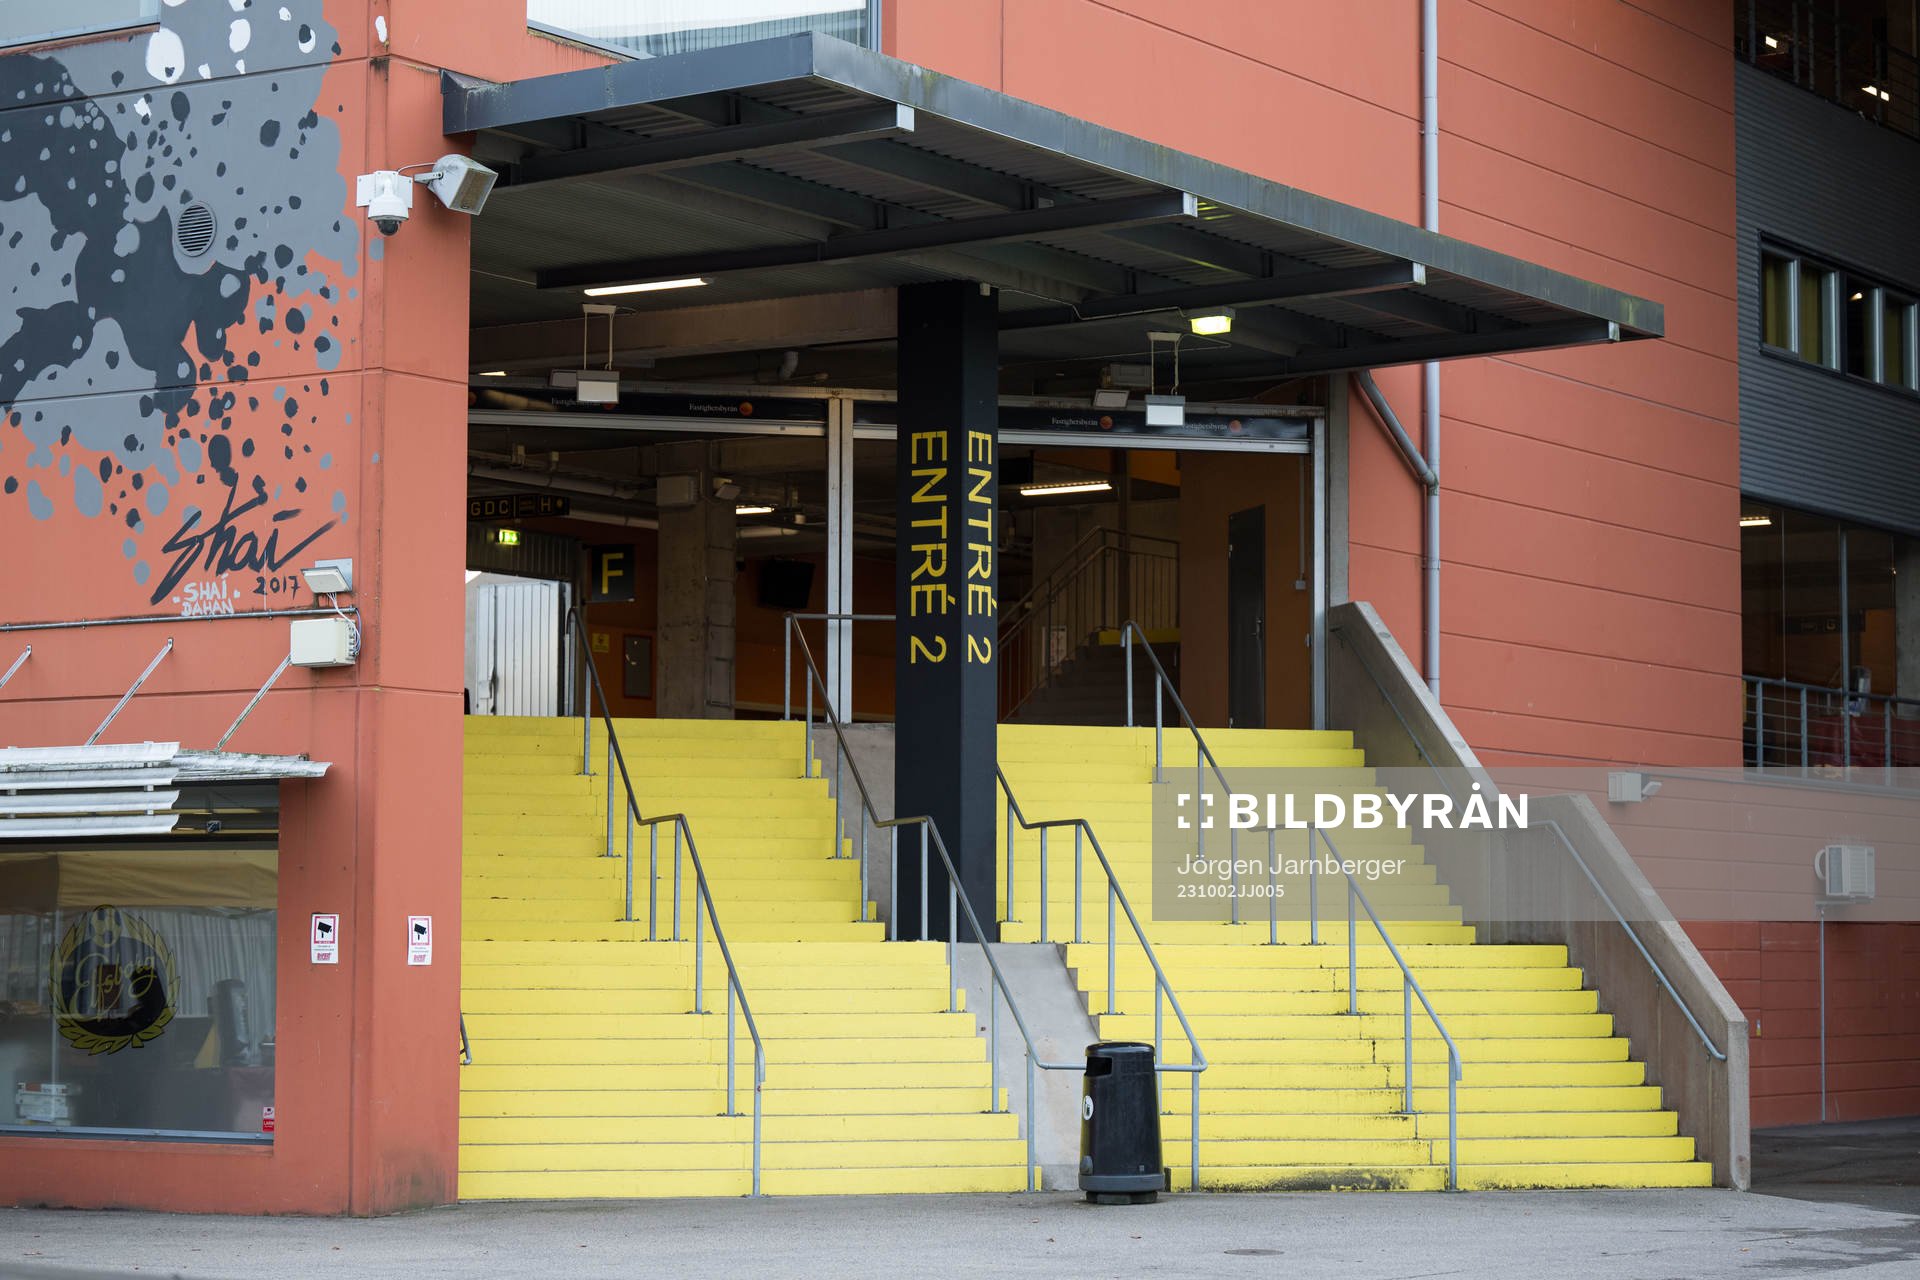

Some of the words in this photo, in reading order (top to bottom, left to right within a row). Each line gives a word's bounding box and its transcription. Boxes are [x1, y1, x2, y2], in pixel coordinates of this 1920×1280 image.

[911, 430, 956, 617] ENTRÉ
[967, 430, 998, 617] ENTRÉ
[252, 575, 302, 600] 2017
[601, 552, 624, 595] F
[181, 597, 235, 617] DAHAN
[910, 636, 947, 664] 2
[967, 634, 993, 664] 2
